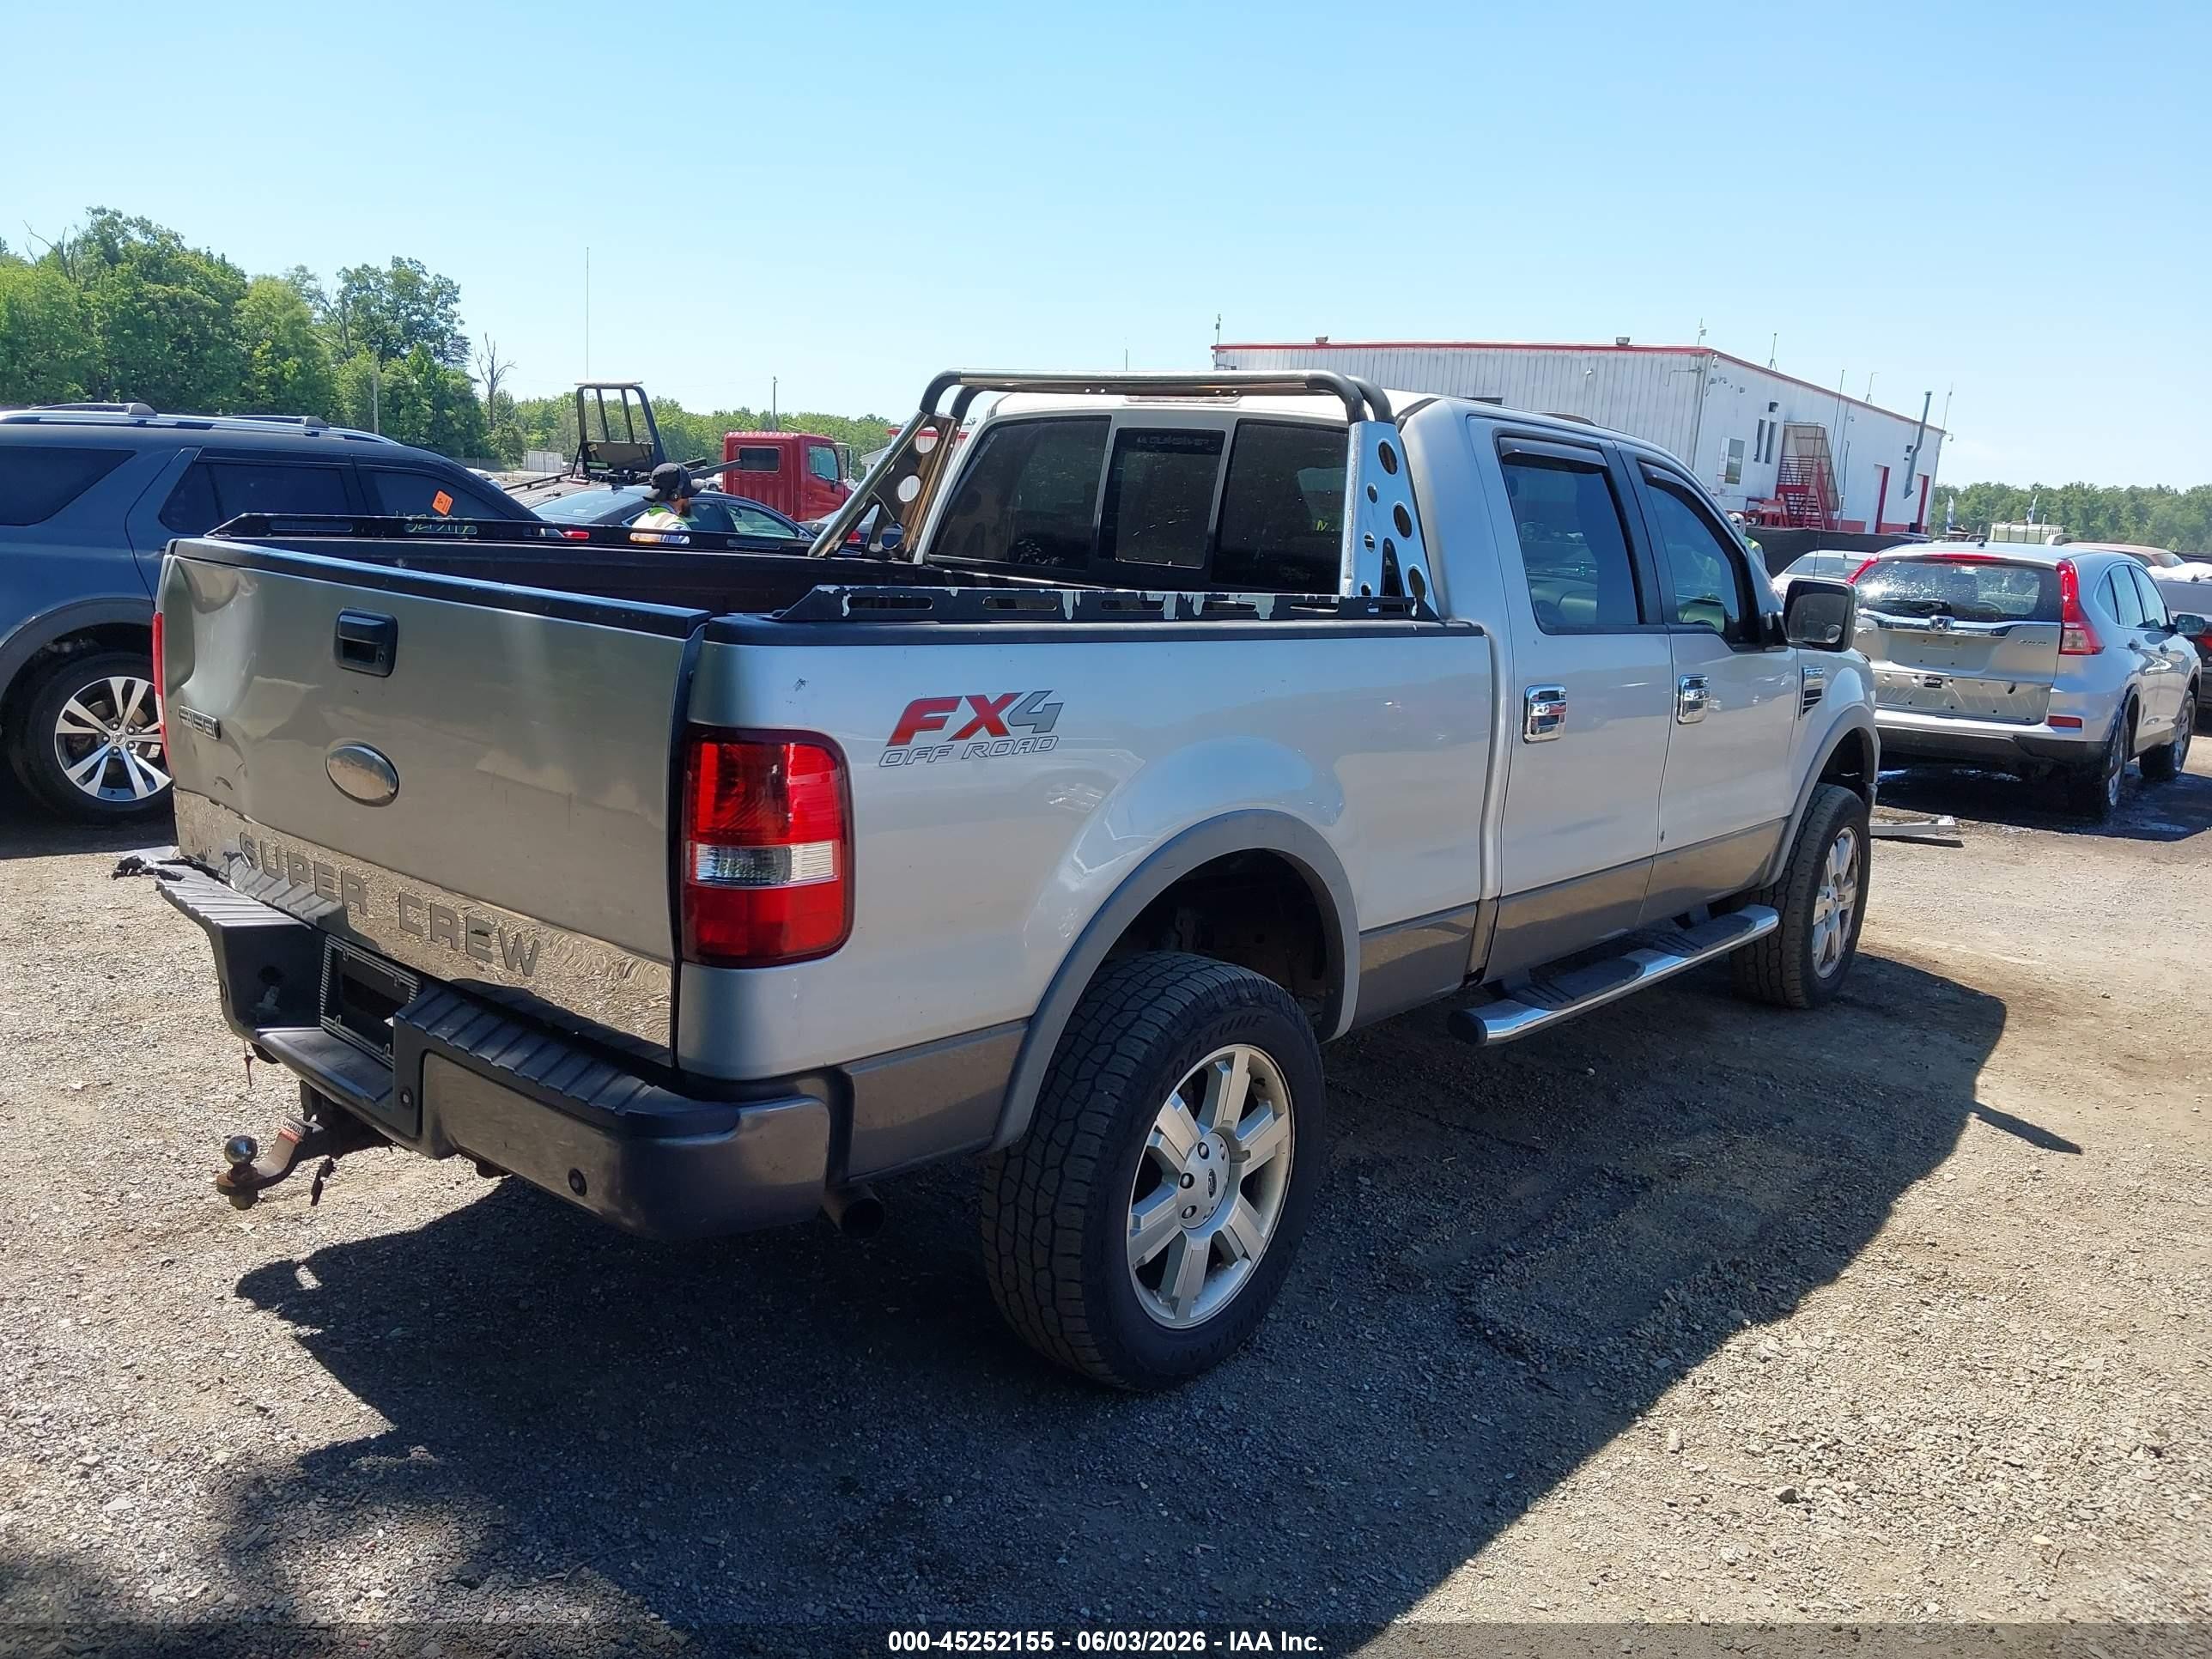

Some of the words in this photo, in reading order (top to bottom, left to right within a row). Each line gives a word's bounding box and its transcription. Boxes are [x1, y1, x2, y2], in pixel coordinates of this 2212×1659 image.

[886, 690, 1064, 746] FX4
[878, 744, 955, 767] OFF
[961, 736, 1059, 760] ROAD
[240, 832, 368, 915] SUPER
[398, 891, 541, 976] CREW
